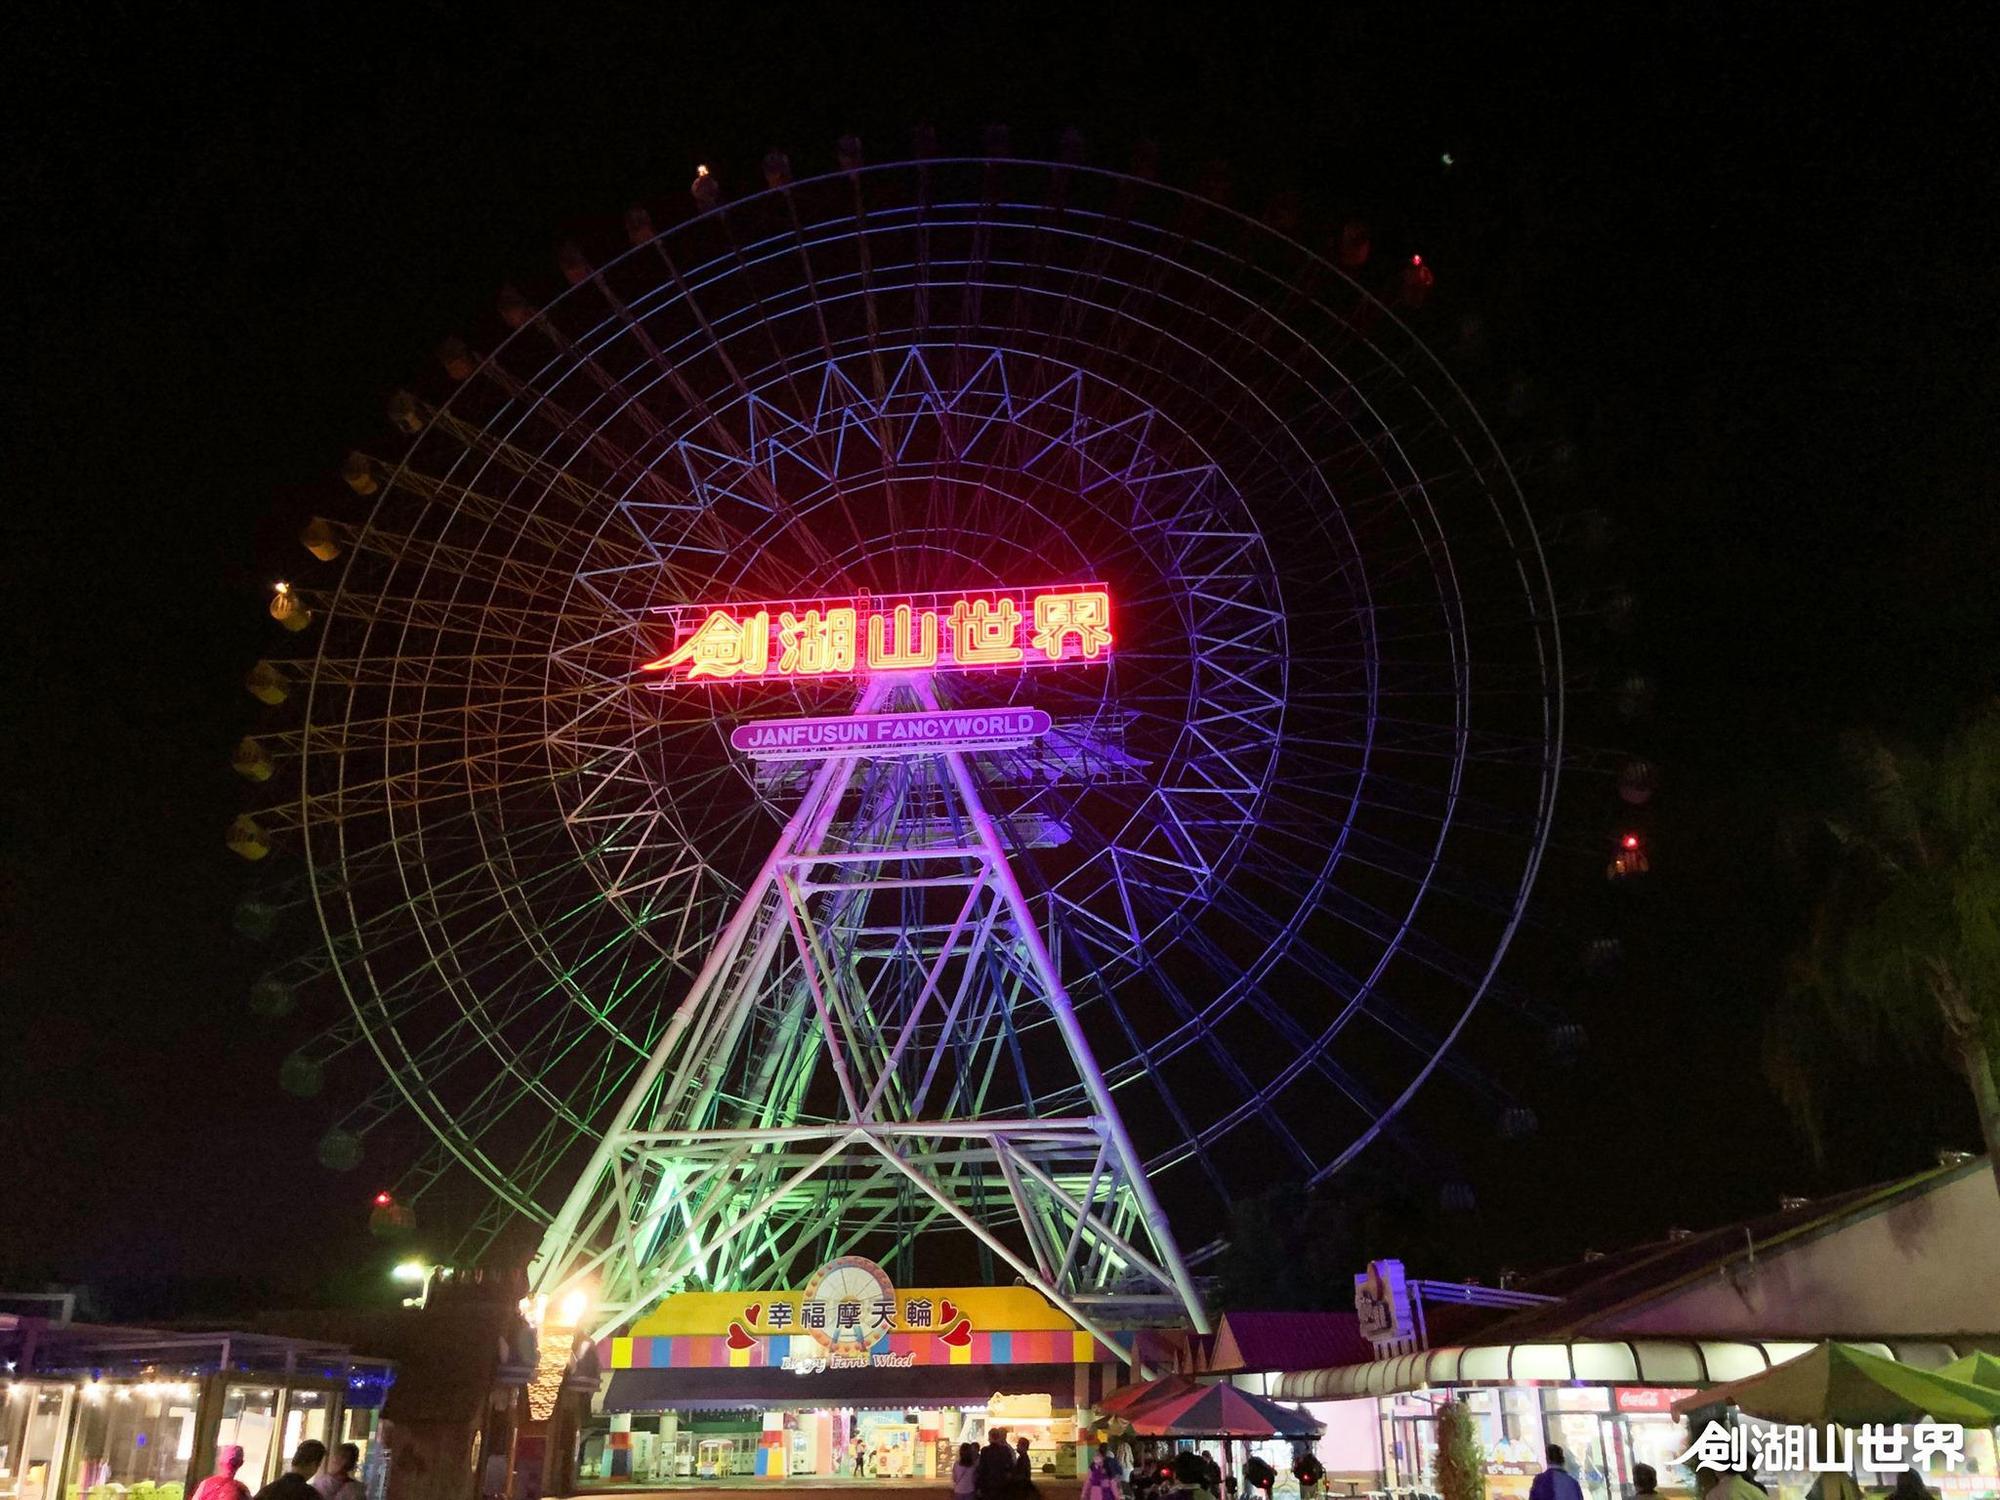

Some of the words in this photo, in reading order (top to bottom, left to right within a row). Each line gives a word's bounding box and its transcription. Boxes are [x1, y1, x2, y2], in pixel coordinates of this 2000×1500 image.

[640, 591, 1112, 680] 劍湖山世界
[748, 724, 868, 747] JANFUSUN
[877, 714, 1034, 740] FANCYWORLD
[767, 1299, 933, 1330] 幸福摩天輪
[829, 1353, 868, 1370] Ferris
[872, 1352, 916, 1368] Wheel
